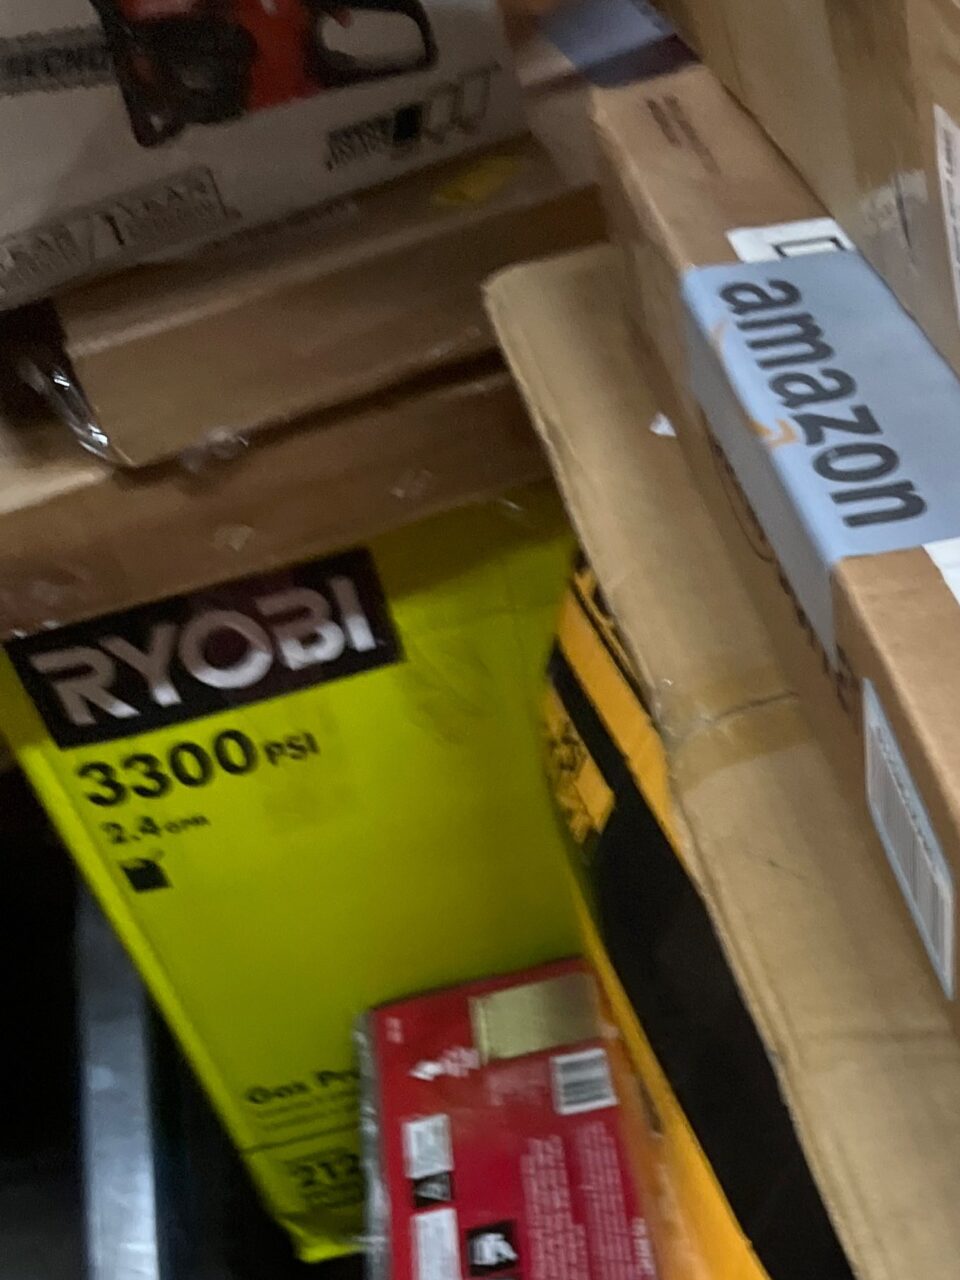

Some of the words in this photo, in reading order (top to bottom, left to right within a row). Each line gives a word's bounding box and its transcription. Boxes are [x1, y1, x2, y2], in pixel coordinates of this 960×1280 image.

[719, 279, 927, 528] amazon
[29, 574, 381, 728] RYOBI
[77, 728, 259, 807] 3300
[263, 731, 321, 766] PSI
[102, 815, 161, 844] 2.4
